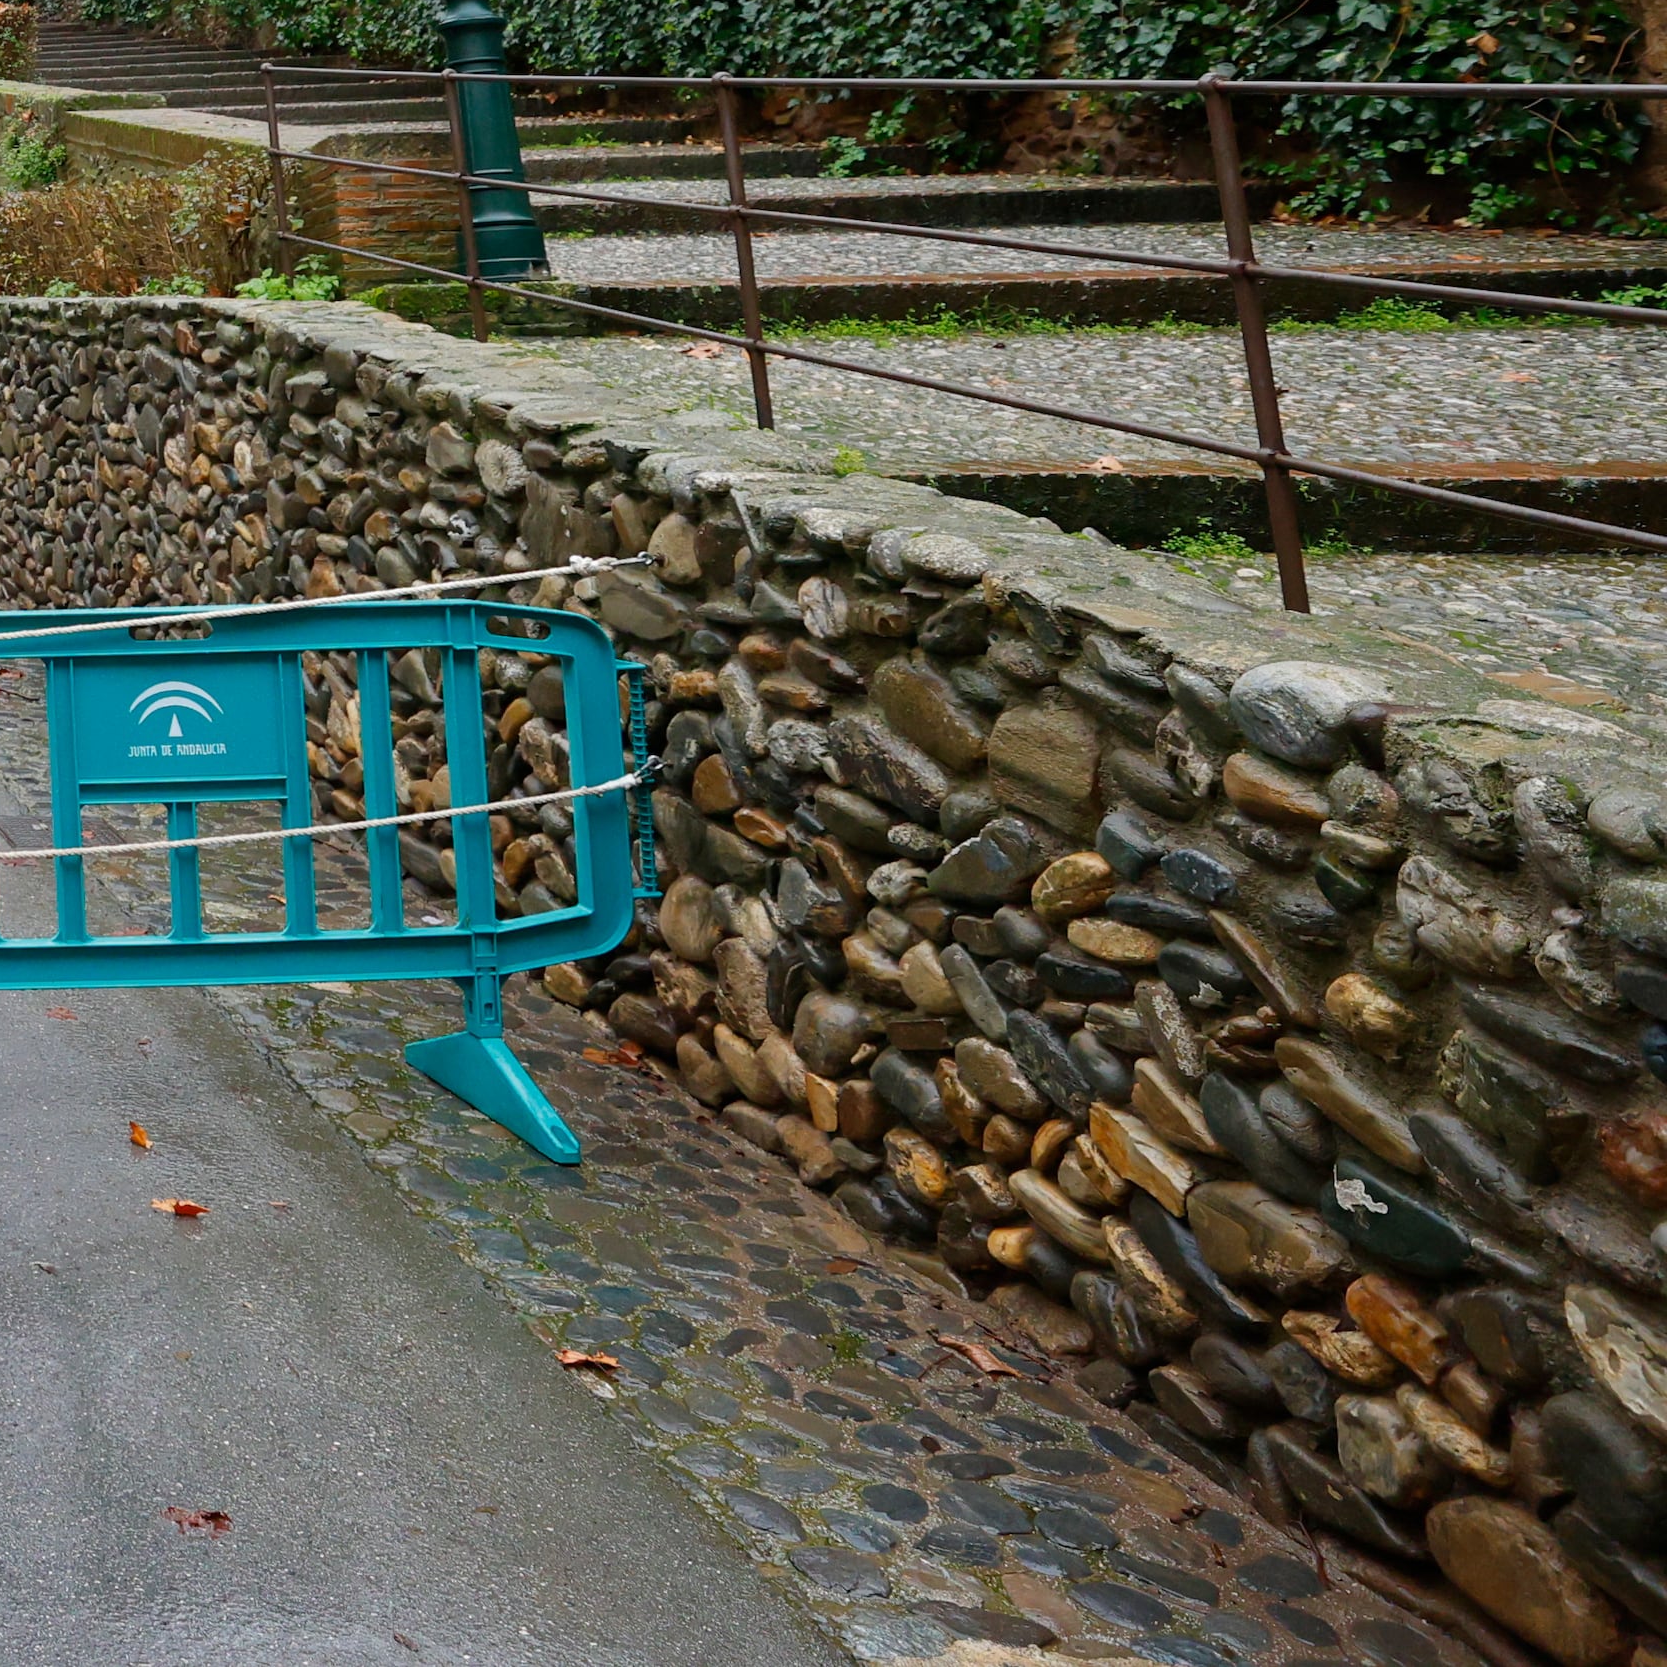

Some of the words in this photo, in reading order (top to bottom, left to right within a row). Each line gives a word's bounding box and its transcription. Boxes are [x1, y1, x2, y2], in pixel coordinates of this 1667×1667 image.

[128, 745, 157, 758] JUNTA
[160, 744, 173, 756] DE
[176, 743, 227, 756] ANDALUCIA
